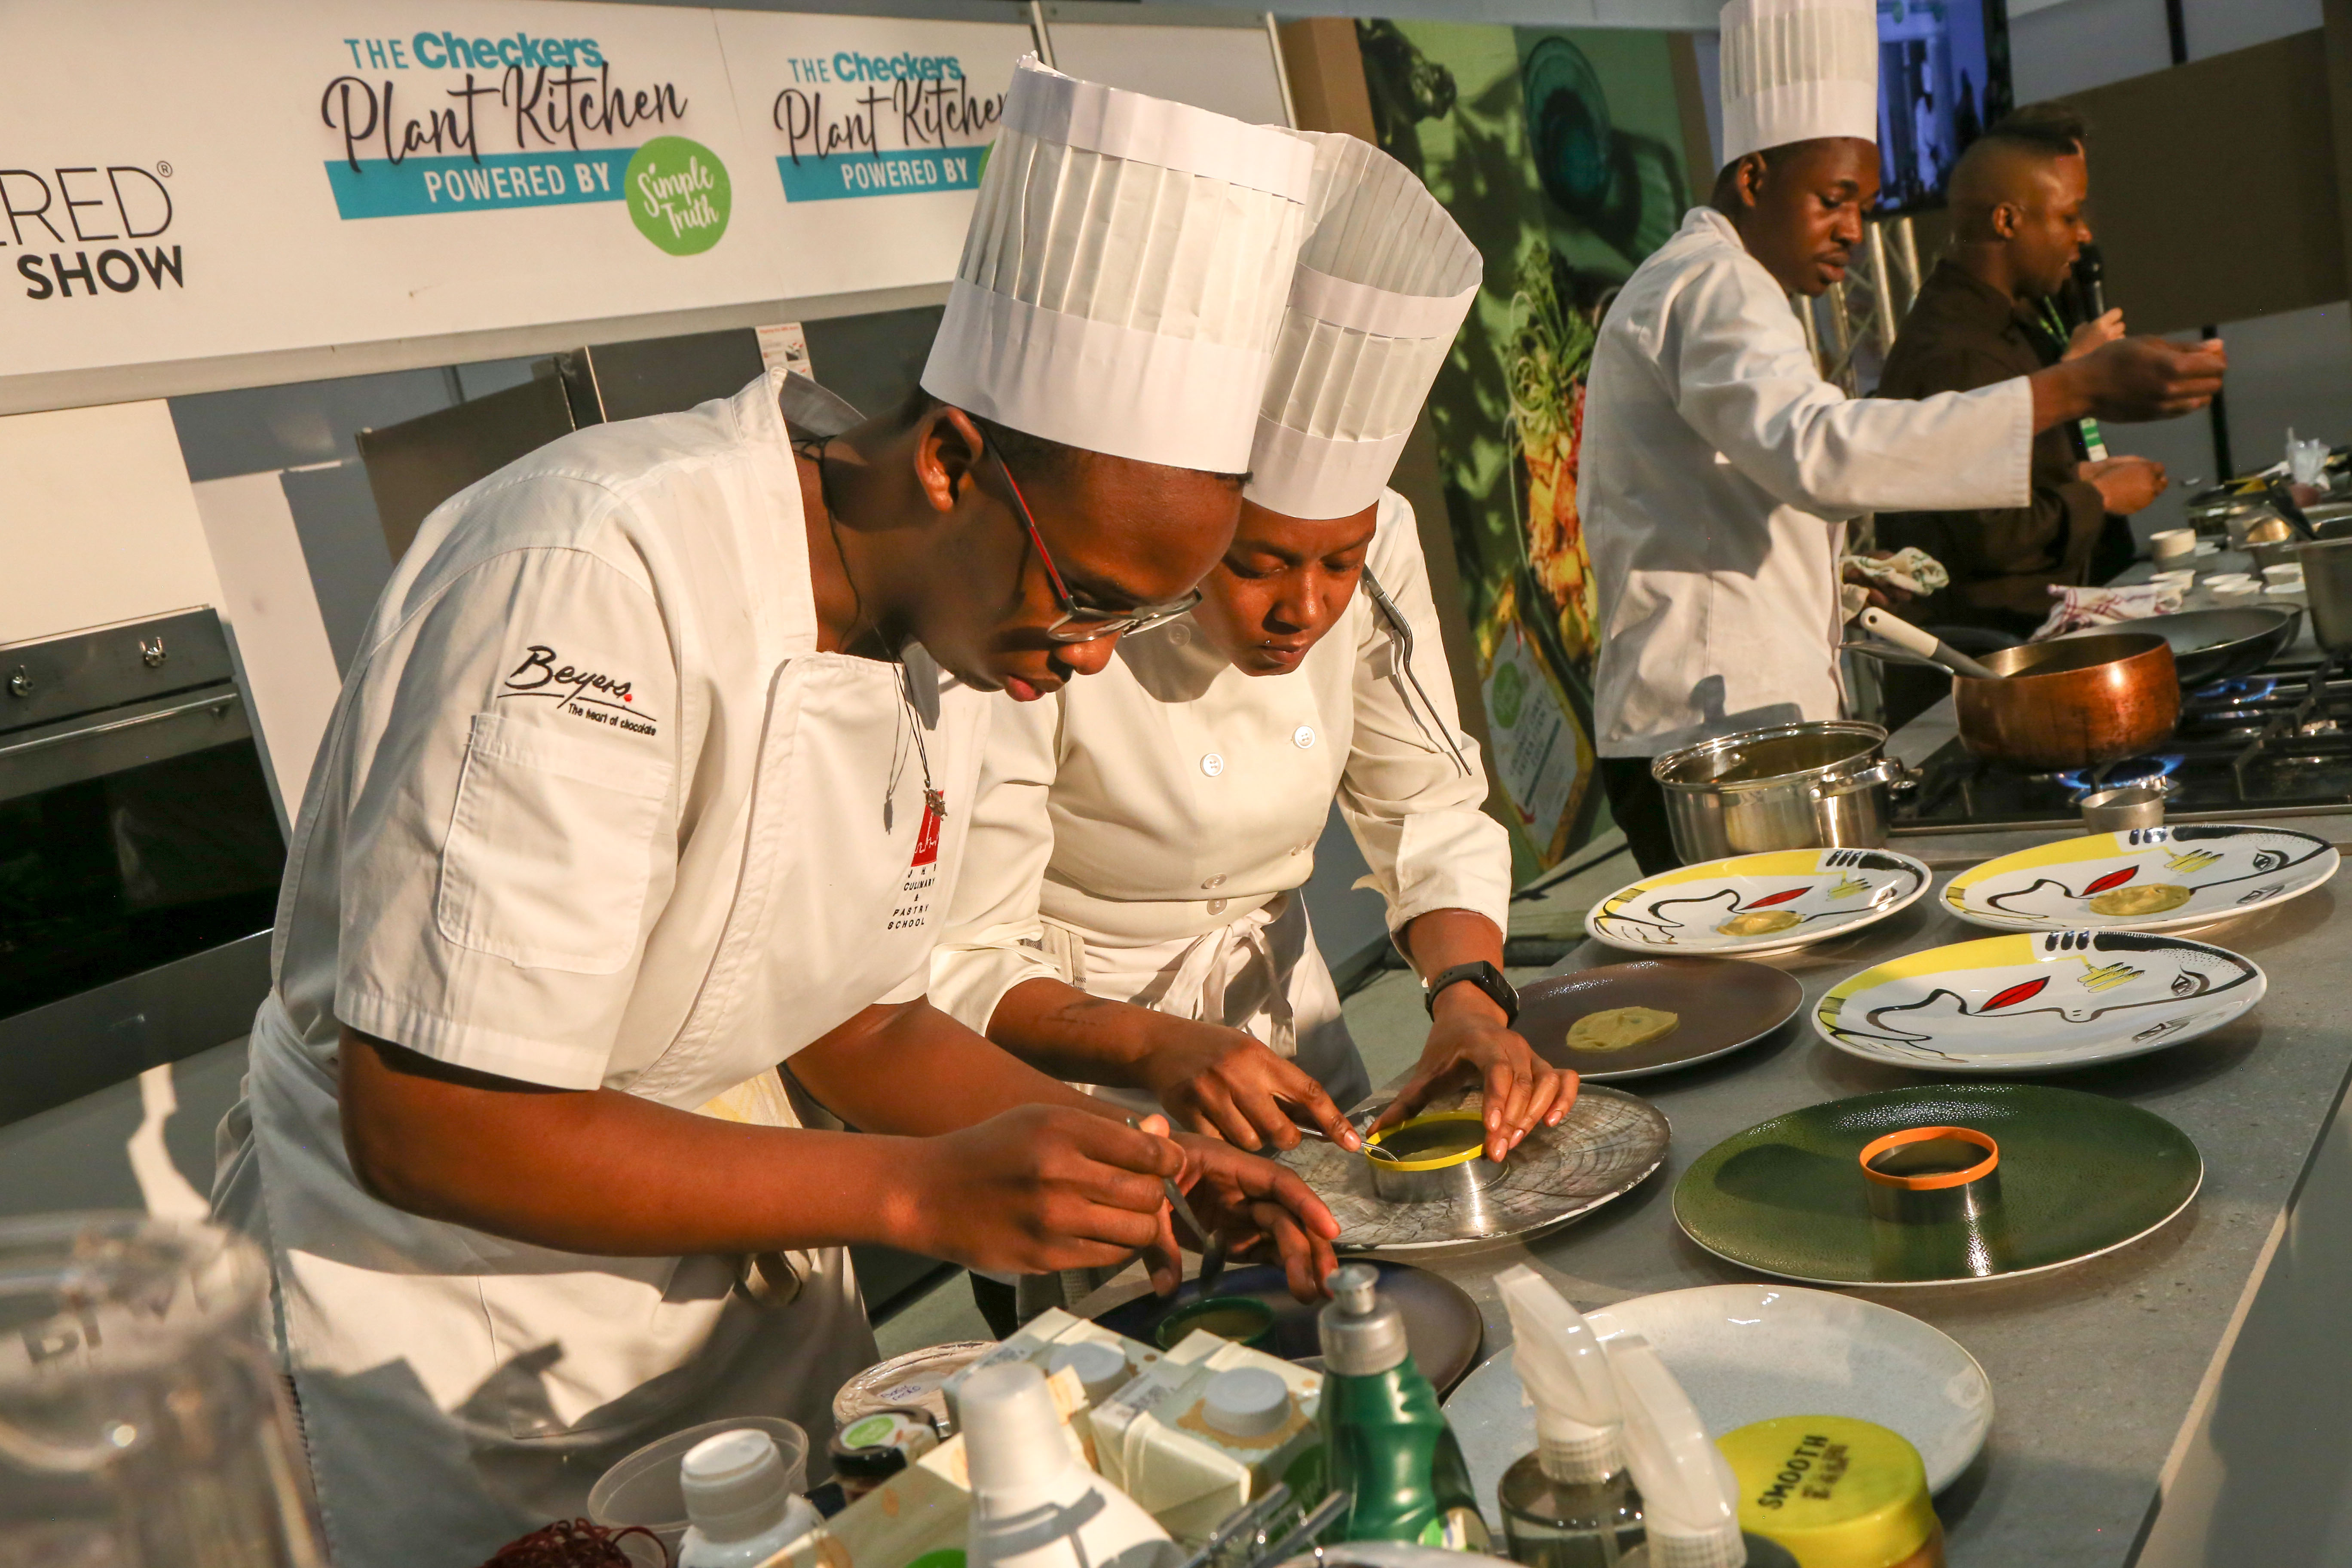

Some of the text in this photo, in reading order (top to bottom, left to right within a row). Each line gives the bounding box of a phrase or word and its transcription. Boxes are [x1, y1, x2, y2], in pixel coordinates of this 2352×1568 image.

[345, 31, 604, 70] THE Checkers
[787, 51, 962, 83] THE Checkers
[321, 60, 688, 174] Plant Kitchen
[774, 86, 892, 167] Plant
[424, 162, 611, 203] POWERED BY
[637, 155, 714, 218] Simple
[840, 157, 968, 190] POWERED BY
[0, 166, 172, 246] RED
[660, 193, 720, 239] Truth
[17, 245, 184, 300] SHOW
[568, 703, 657, 736] The heart of chocolate
[903, 877, 936, 891] CULINARY
[887, 917, 925, 930] SCHOOL
[892, 904, 929, 917] PASTRY
[1757, 1434, 1830, 1510] SMOOTH
